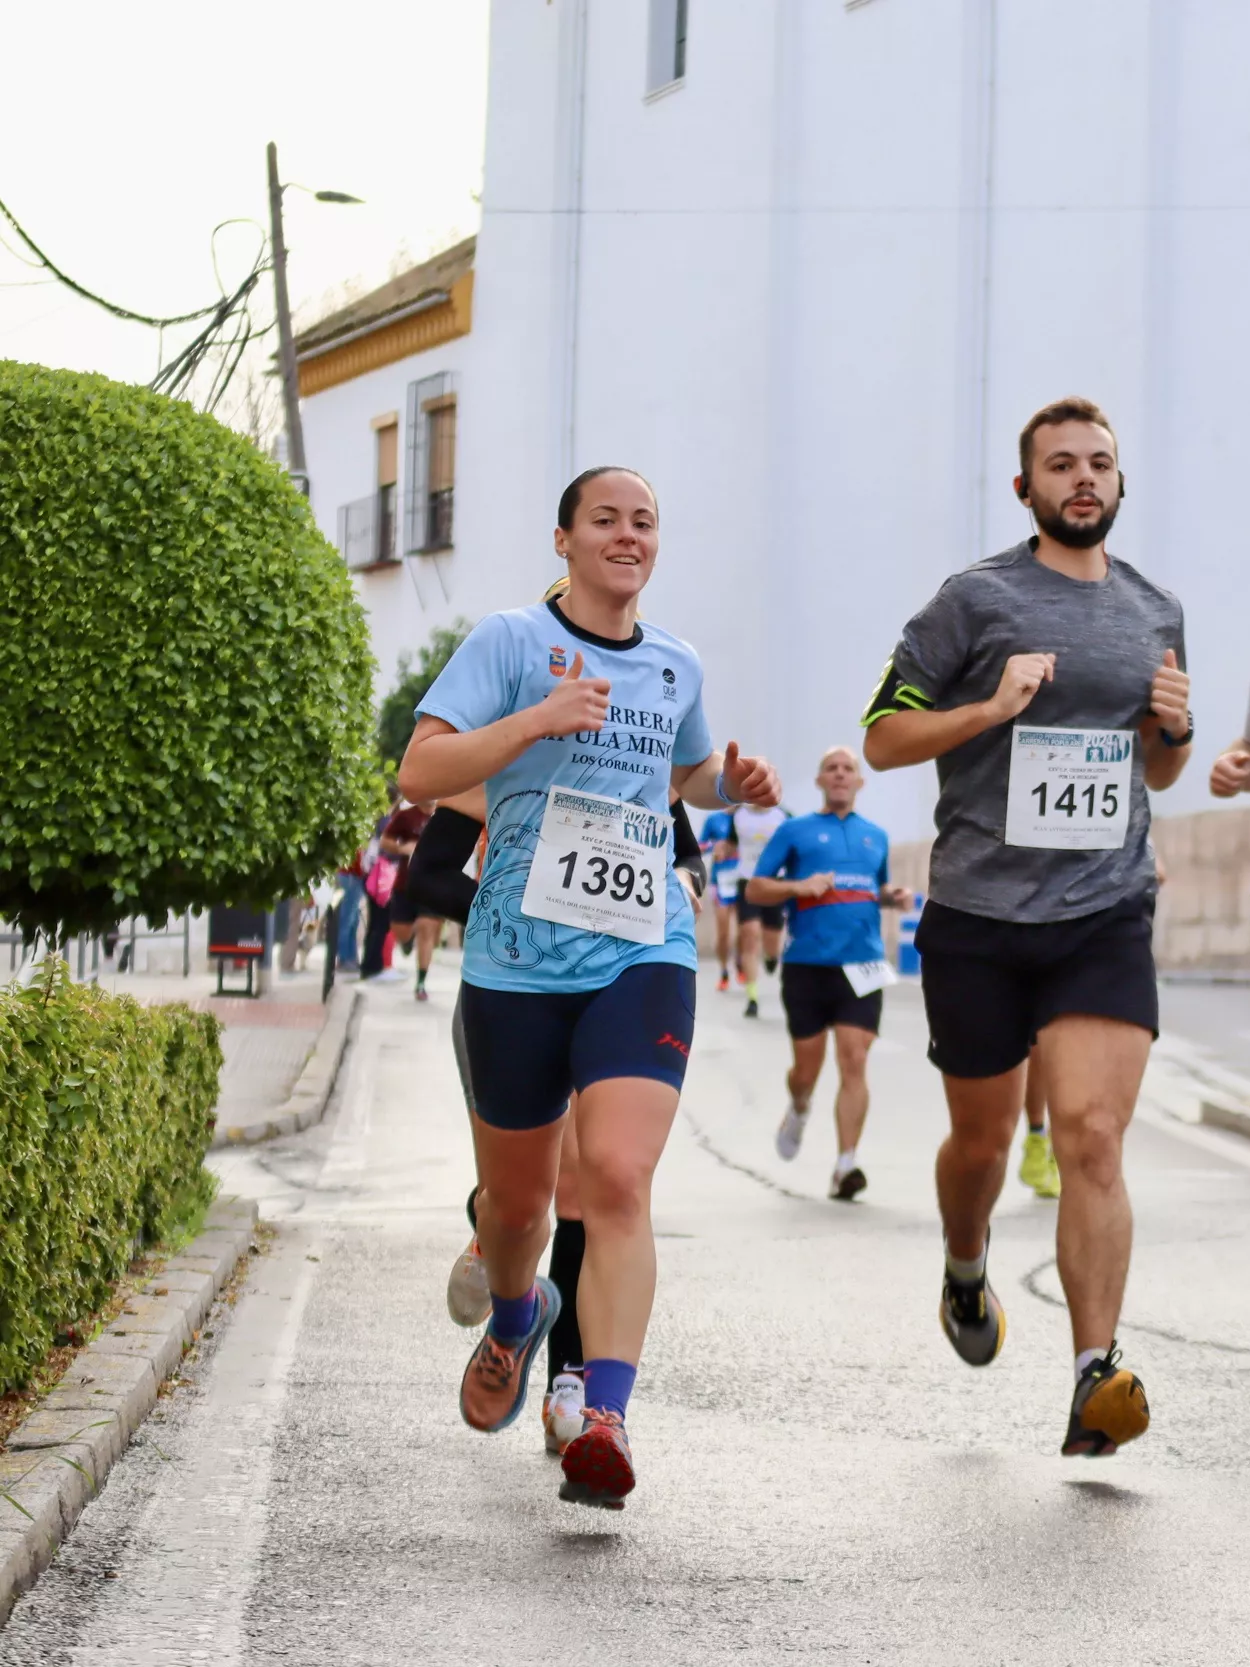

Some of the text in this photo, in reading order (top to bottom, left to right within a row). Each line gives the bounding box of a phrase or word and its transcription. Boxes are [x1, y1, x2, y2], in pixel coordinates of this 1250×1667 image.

[604, 705, 673, 735] RRERA
[1084, 733, 1113, 748] 2024
[571, 753, 655, 777] LOS CORRALES
[553, 800, 589, 813] CARRERAS
[1031, 782, 1118, 818] 1415
[621, 808, 649, 828] 2024
[581, 835, 594, 843] XXV
[605, 841, 625, 850] CIUDAD
[591, 846, 603, 854] POR
[557, 850, 655, 908] 1393
